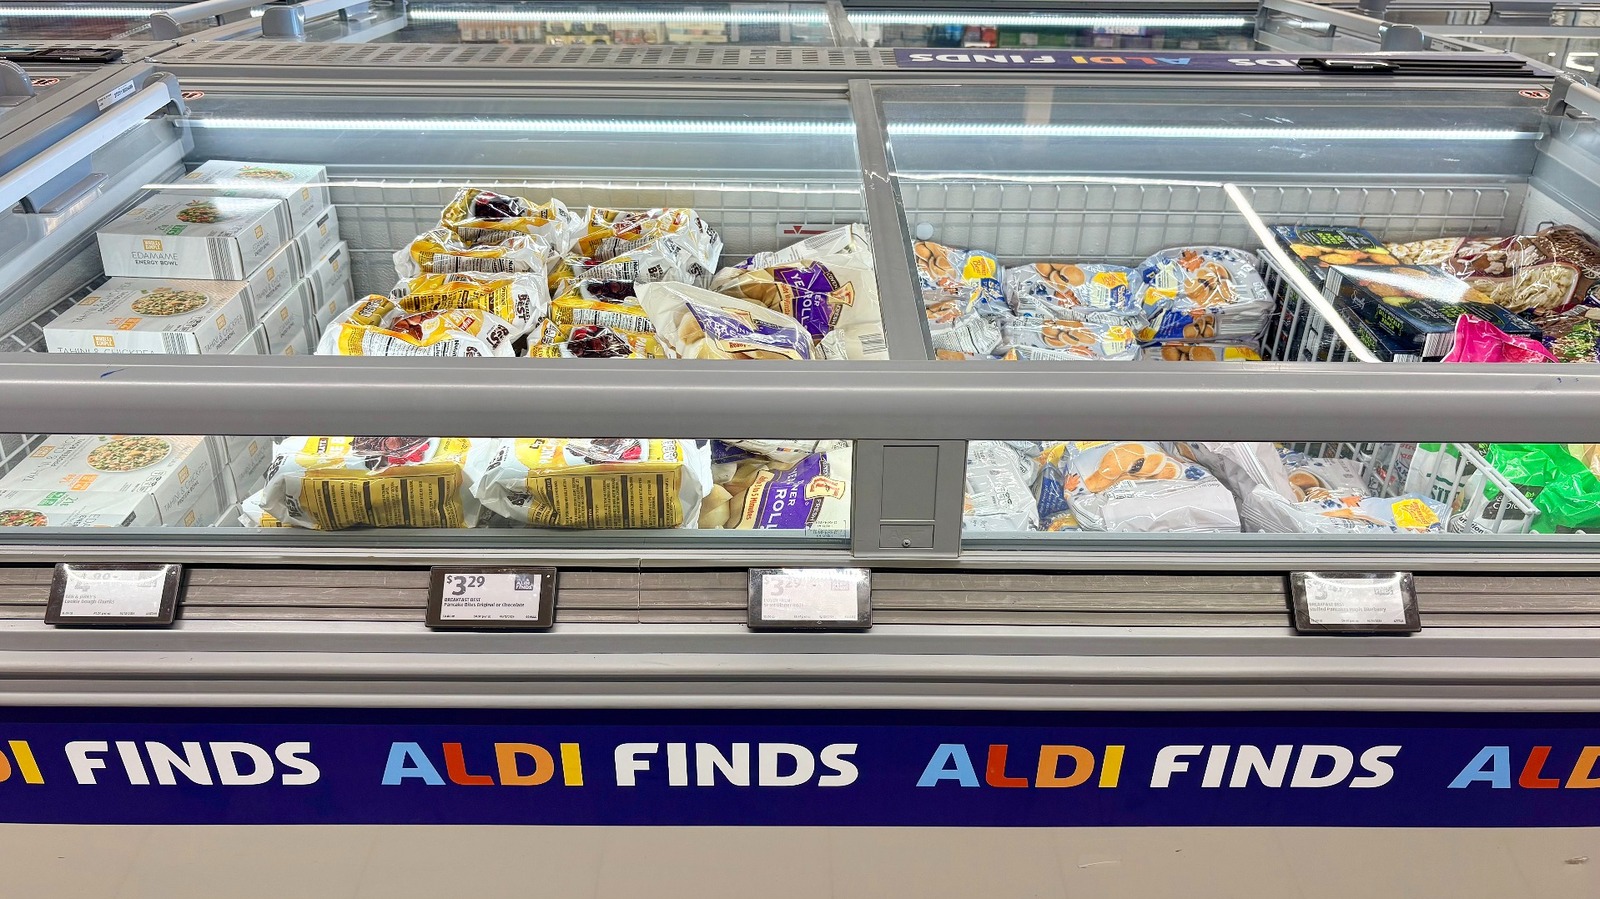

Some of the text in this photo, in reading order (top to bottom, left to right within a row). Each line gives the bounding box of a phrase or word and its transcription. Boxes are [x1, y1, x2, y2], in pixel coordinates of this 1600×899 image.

[909, 53, 1056, 63] FINDS
[1072, 56, 1190, 65] ALDI
[131, 252, 178, 260] EDAMAME
[746, 497, 758, 520] Minutes
[767, 488, 788, 529] ROLL
[65, 741, 320, 785] FINDS
[382, 742, 583, 786] ALDI
[615, 743, 858, 786] FINDS
[916, 744, 1125, 787] ALDI
[1150, 745, 1402, 787] FINDS
